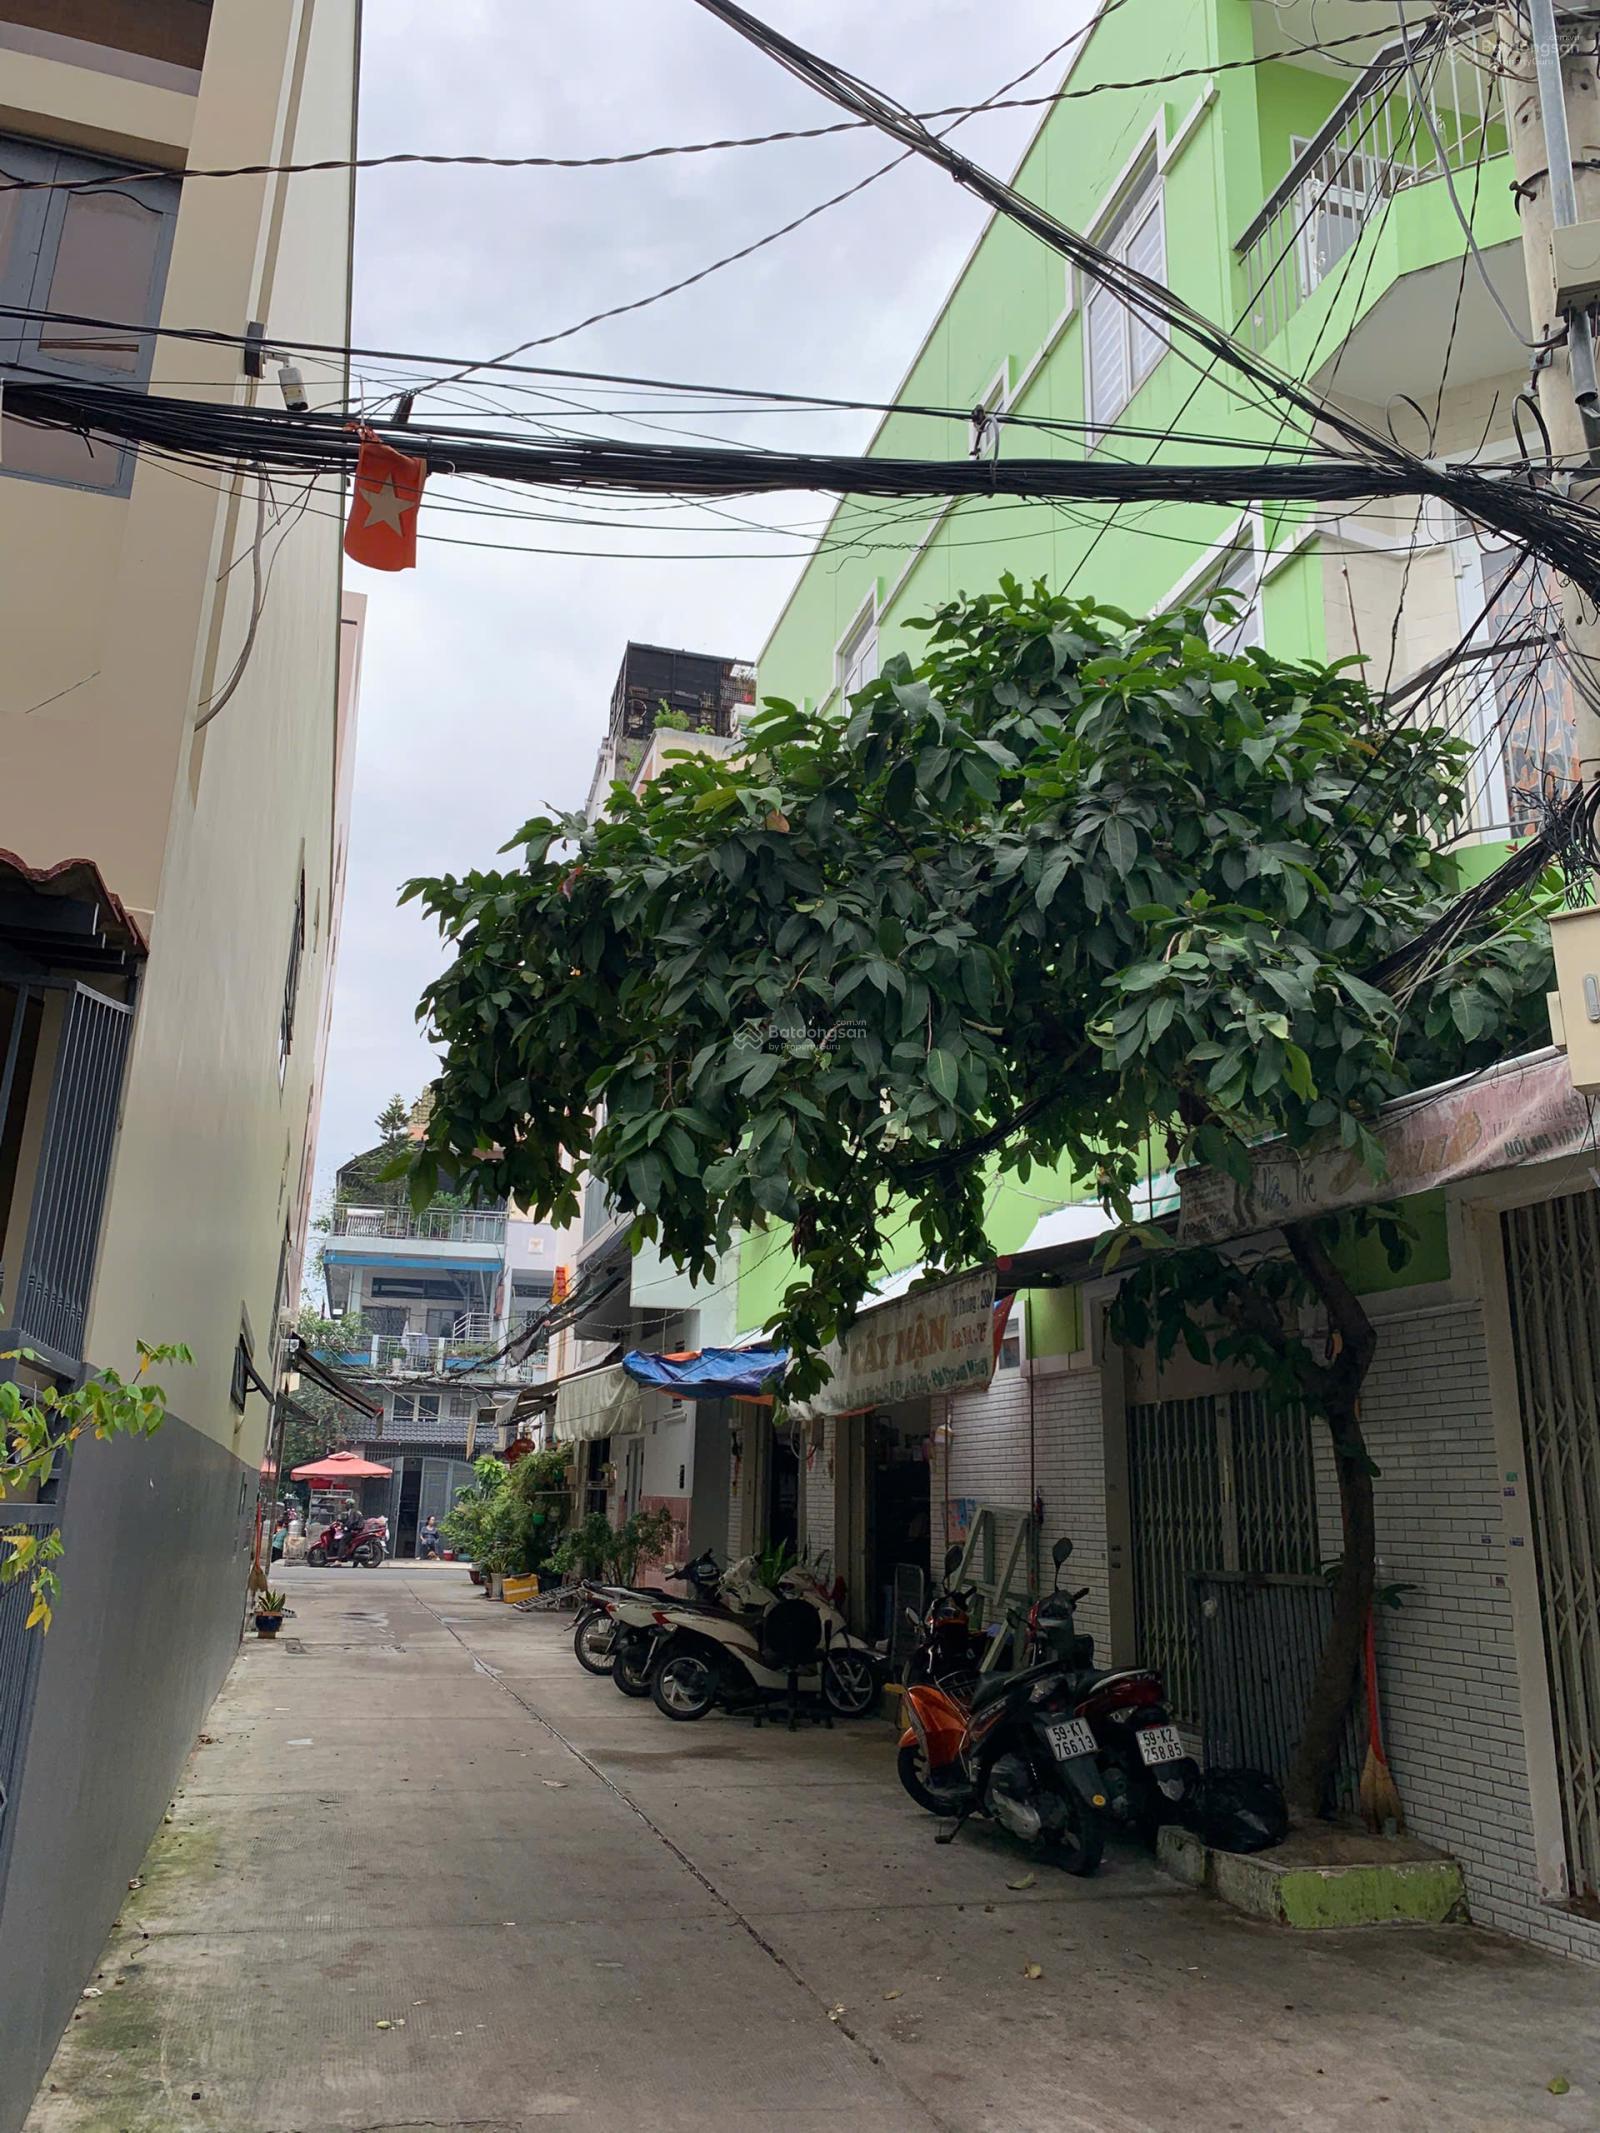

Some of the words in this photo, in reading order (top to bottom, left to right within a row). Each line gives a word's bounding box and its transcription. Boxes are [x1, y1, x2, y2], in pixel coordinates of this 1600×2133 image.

[1052, 1721, 1084, 1741] 59-K1
[1054, 1735, 1095, 1760] 766.13
[1143, 1742, 1183, 1763] 258.85
